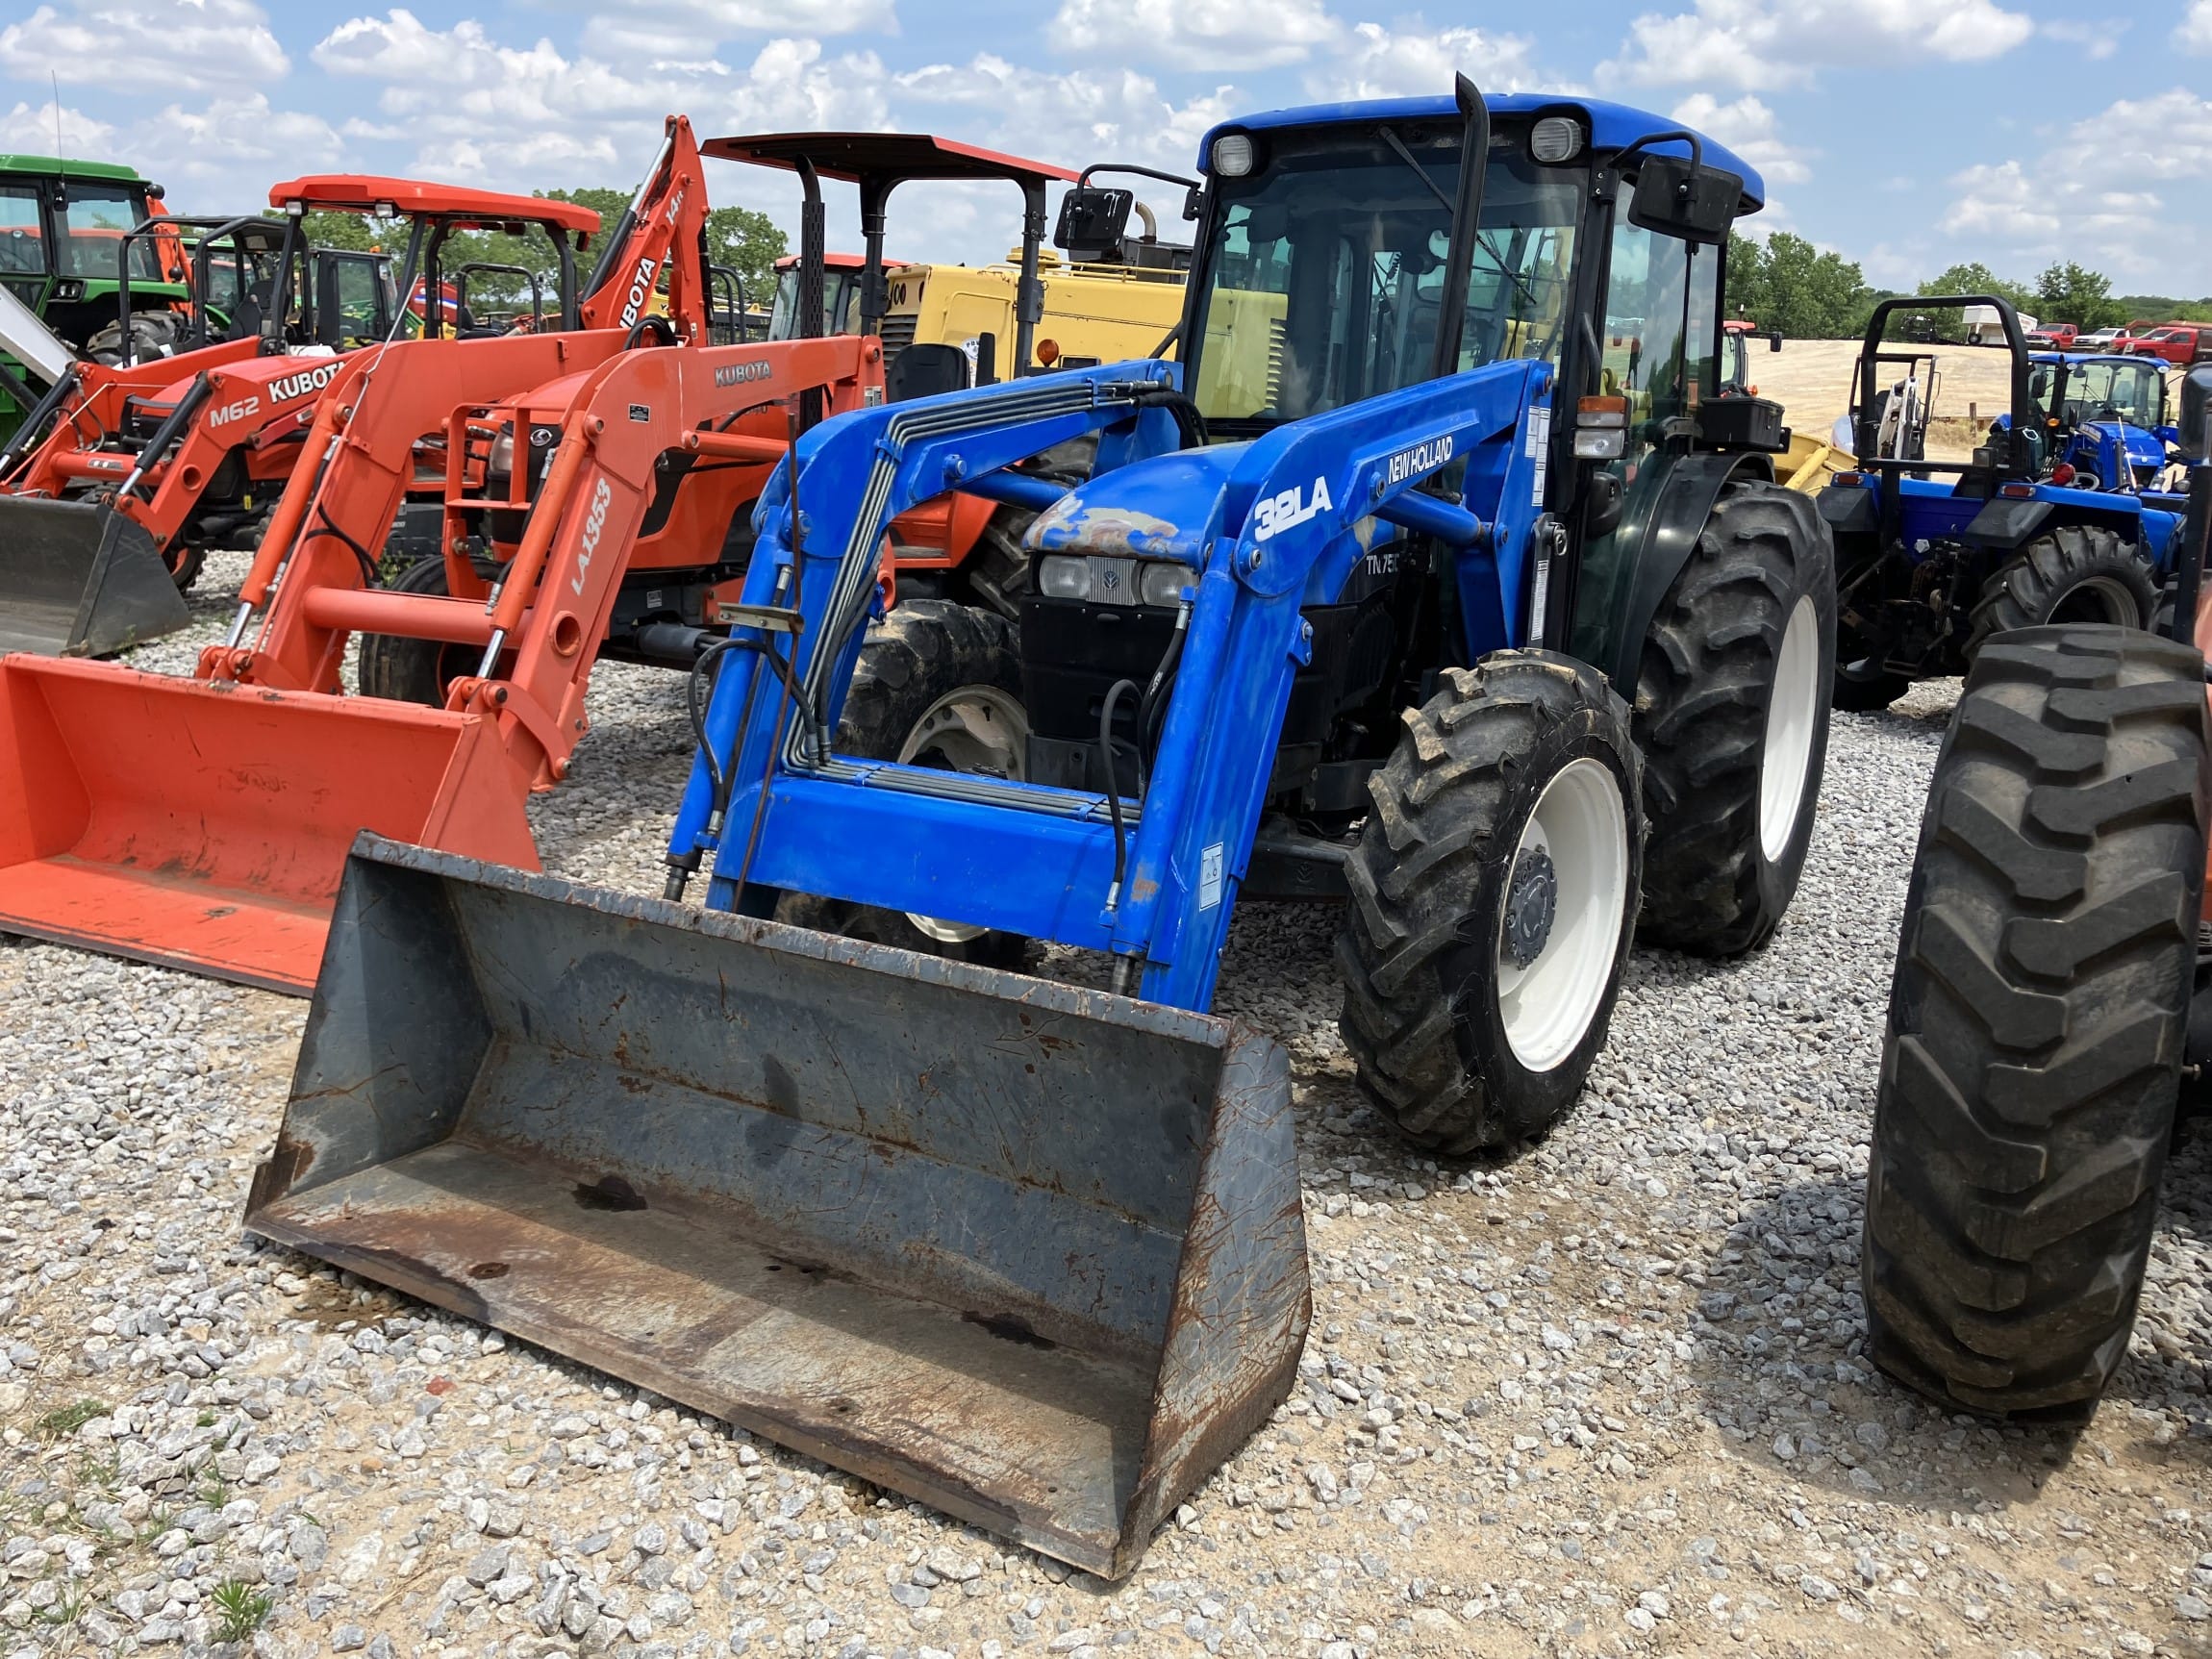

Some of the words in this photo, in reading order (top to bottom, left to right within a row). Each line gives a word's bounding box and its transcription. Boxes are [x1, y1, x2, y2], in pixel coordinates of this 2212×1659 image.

[715, 359, 772, 388] KUBOTA
[209, 395, 261, 428] M62
[1388, 448, 1412, 486] NEW
[1410, 435, 1454, 476] HOLLAND
[571, 477, 612, 596] LA1353
